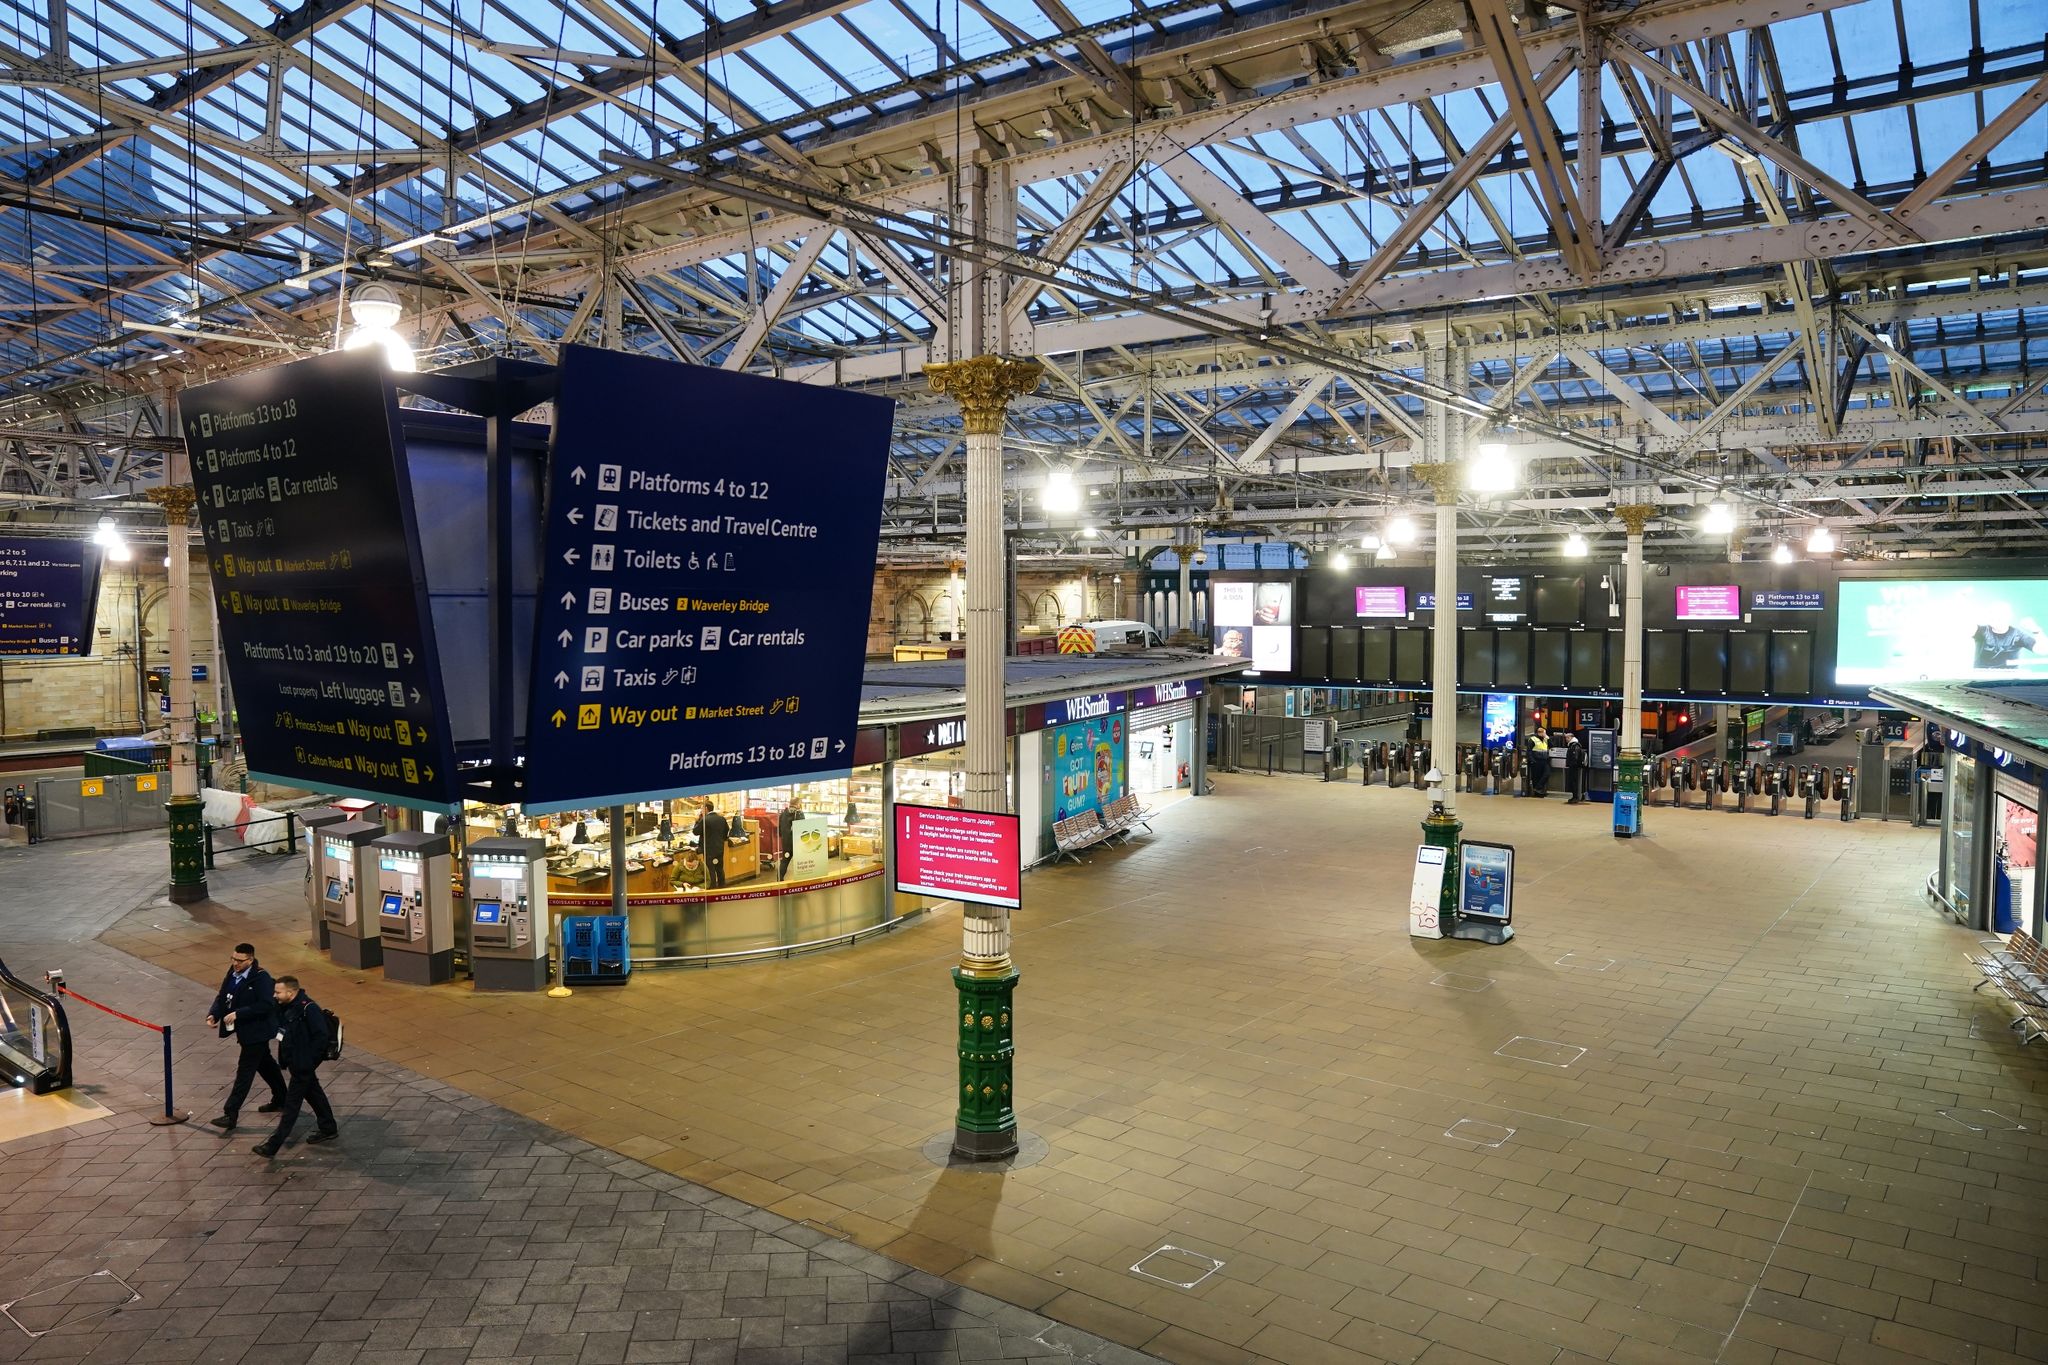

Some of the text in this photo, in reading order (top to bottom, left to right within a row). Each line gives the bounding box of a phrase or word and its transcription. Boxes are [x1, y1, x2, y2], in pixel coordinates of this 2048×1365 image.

[213, 398, 297, 432] Platforms 13 to 18
[220, 438, 297, 468] Platforms 4 to 12
[225, 471, 338, 504] Car parks Car rentals
[629, 470, 769, 500] Platforms 4 to 12
[231, 521, 254, 539] Taxis
[627, 509, 818, 539] Tickets and Travel Centre
[237, 557, 256, 577] Way
[257, 558, 272, 573] out
[306, 559, 327, 571] Street
[623, 548, 681, 569] Toilets
[243, 594, 342, 615] Way out Waverley Bridge
[619, 592, 669, 612] Buses
[691, 600, 737, 613] Waverley
[739, 600, 770, 613] Bridge
[615, 627, 805, 652] Car parks Car rentals
[243, 642, 379, 664] Platforms 1 to 3 and 19 to 20
[613, 669, 657, 687] Taxis
[279, 681, 386, 706] Lost property Left luggage
[1155, 680, 1187, 703] WHSmith
[161, 699, 168, 709] 12
[1066, 694, 1110, 721] WHSmith
[1419, 706, 1430, 715] 14
[610, 706, 647, 727] Way
[650, 704, 678, 722] out
[699, 707, 734, 719] Market
[735, 704, 764, 717] Street
[1581, 712, 1594, 722] 15
[295, 718, 393, 742] Princes Street Way out
[938, 721, 962, 746] PRET A
[1888, 725, 1903, 736] 16
[669, 742, 805, 771] Platforms 13 to 18
[1071, 742, 1083, 752] extra
[354, 754, 379, 778] Way
[380, 760, 399, 778] out
[1070, 757, 1084, 771] GOT
[1062, 769, 1091, 797] FRUITY
[1068, 794, 1086, 811] GUM?
[936, 814, 959, 822] Disruption
[809, 881, 833, 890] AMERICANO
[576, 931, 592, 940] FREE
[606, 931, 622, 940] FREE
